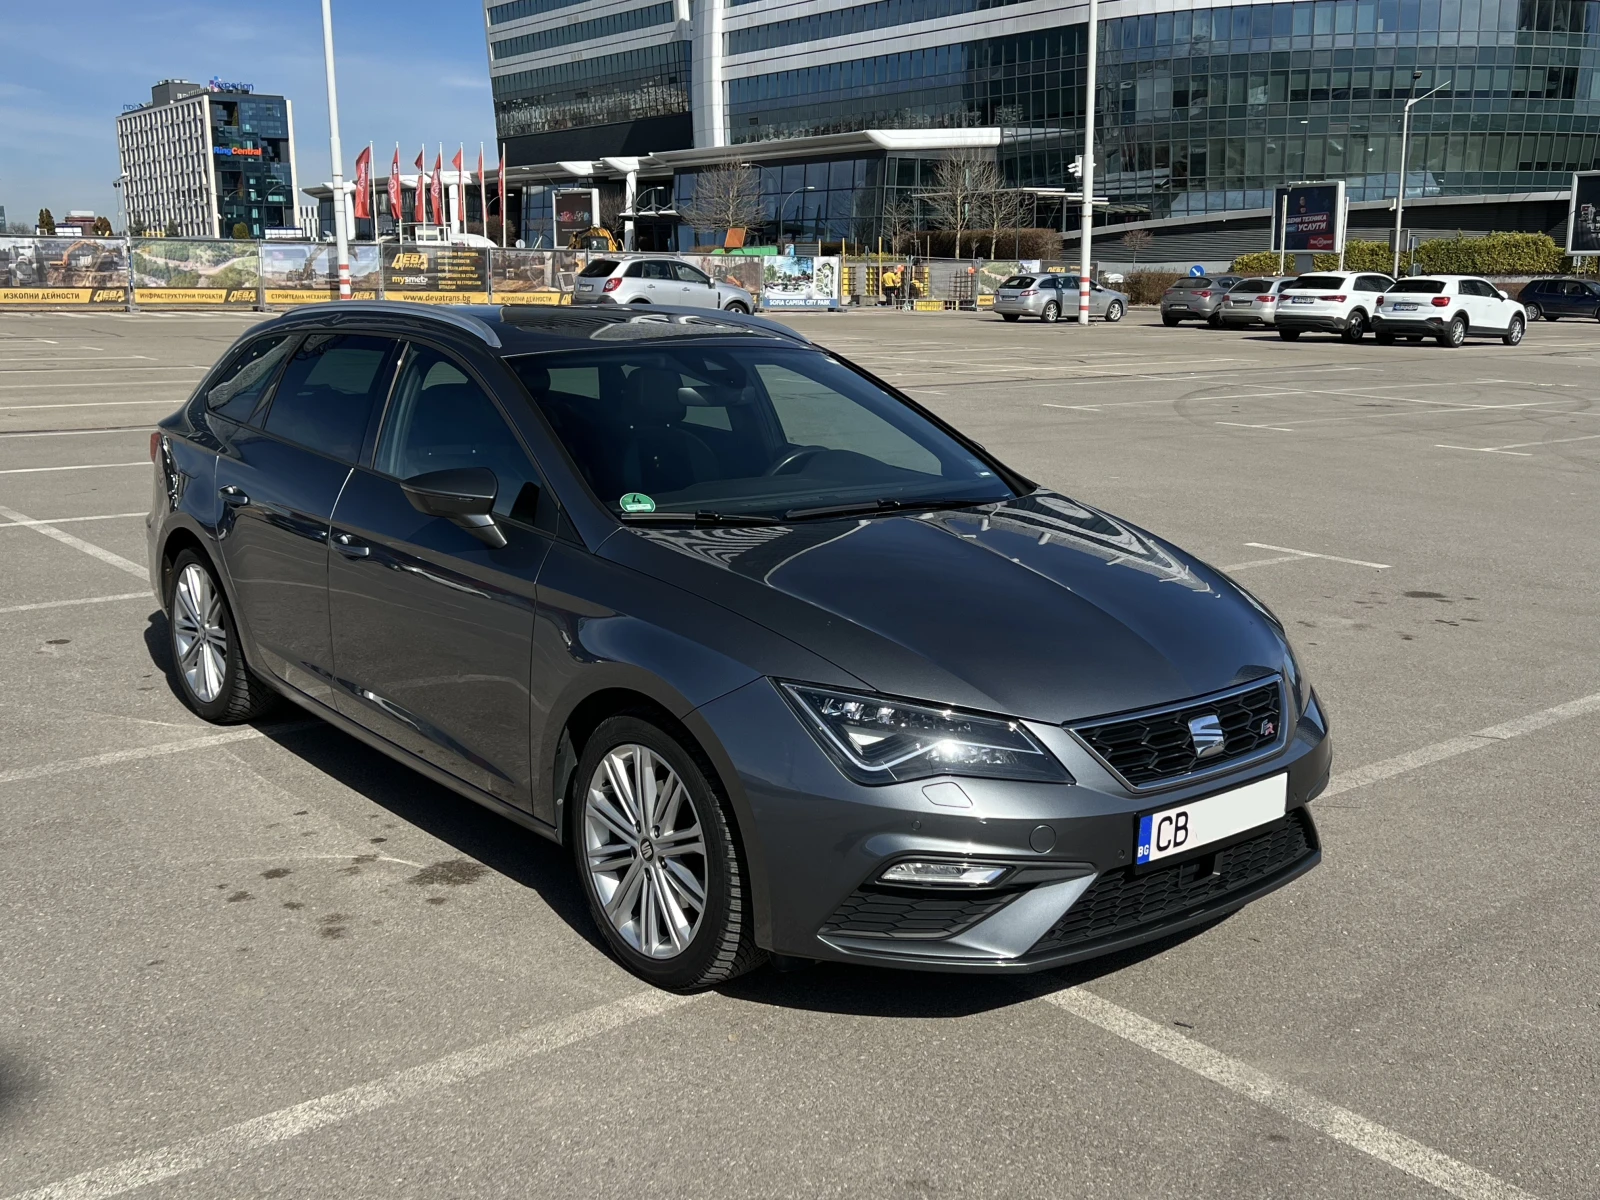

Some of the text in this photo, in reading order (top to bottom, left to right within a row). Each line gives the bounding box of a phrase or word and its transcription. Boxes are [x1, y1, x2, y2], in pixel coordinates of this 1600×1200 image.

[213, 146, 262, 156] RingCentral
[1286, 214, 1327, 224] ЗЕМИ ТЕХНИКА
[1298, 222, 1327, 232] УСЛУГИ
[391, 252, 428, 268] ДЕВА
[3, 291, 80, 300] ИЗКОПНИ ДЕЙНОСТИ
[94, 289, 125, 302] ДЕВА
[403, 294, 471, 303] www.devatrans.bg
[632, 494, 642, 504] 4
[1156, 811, 1189, 853] CB
[1137, 844, 1150, 858] BG
